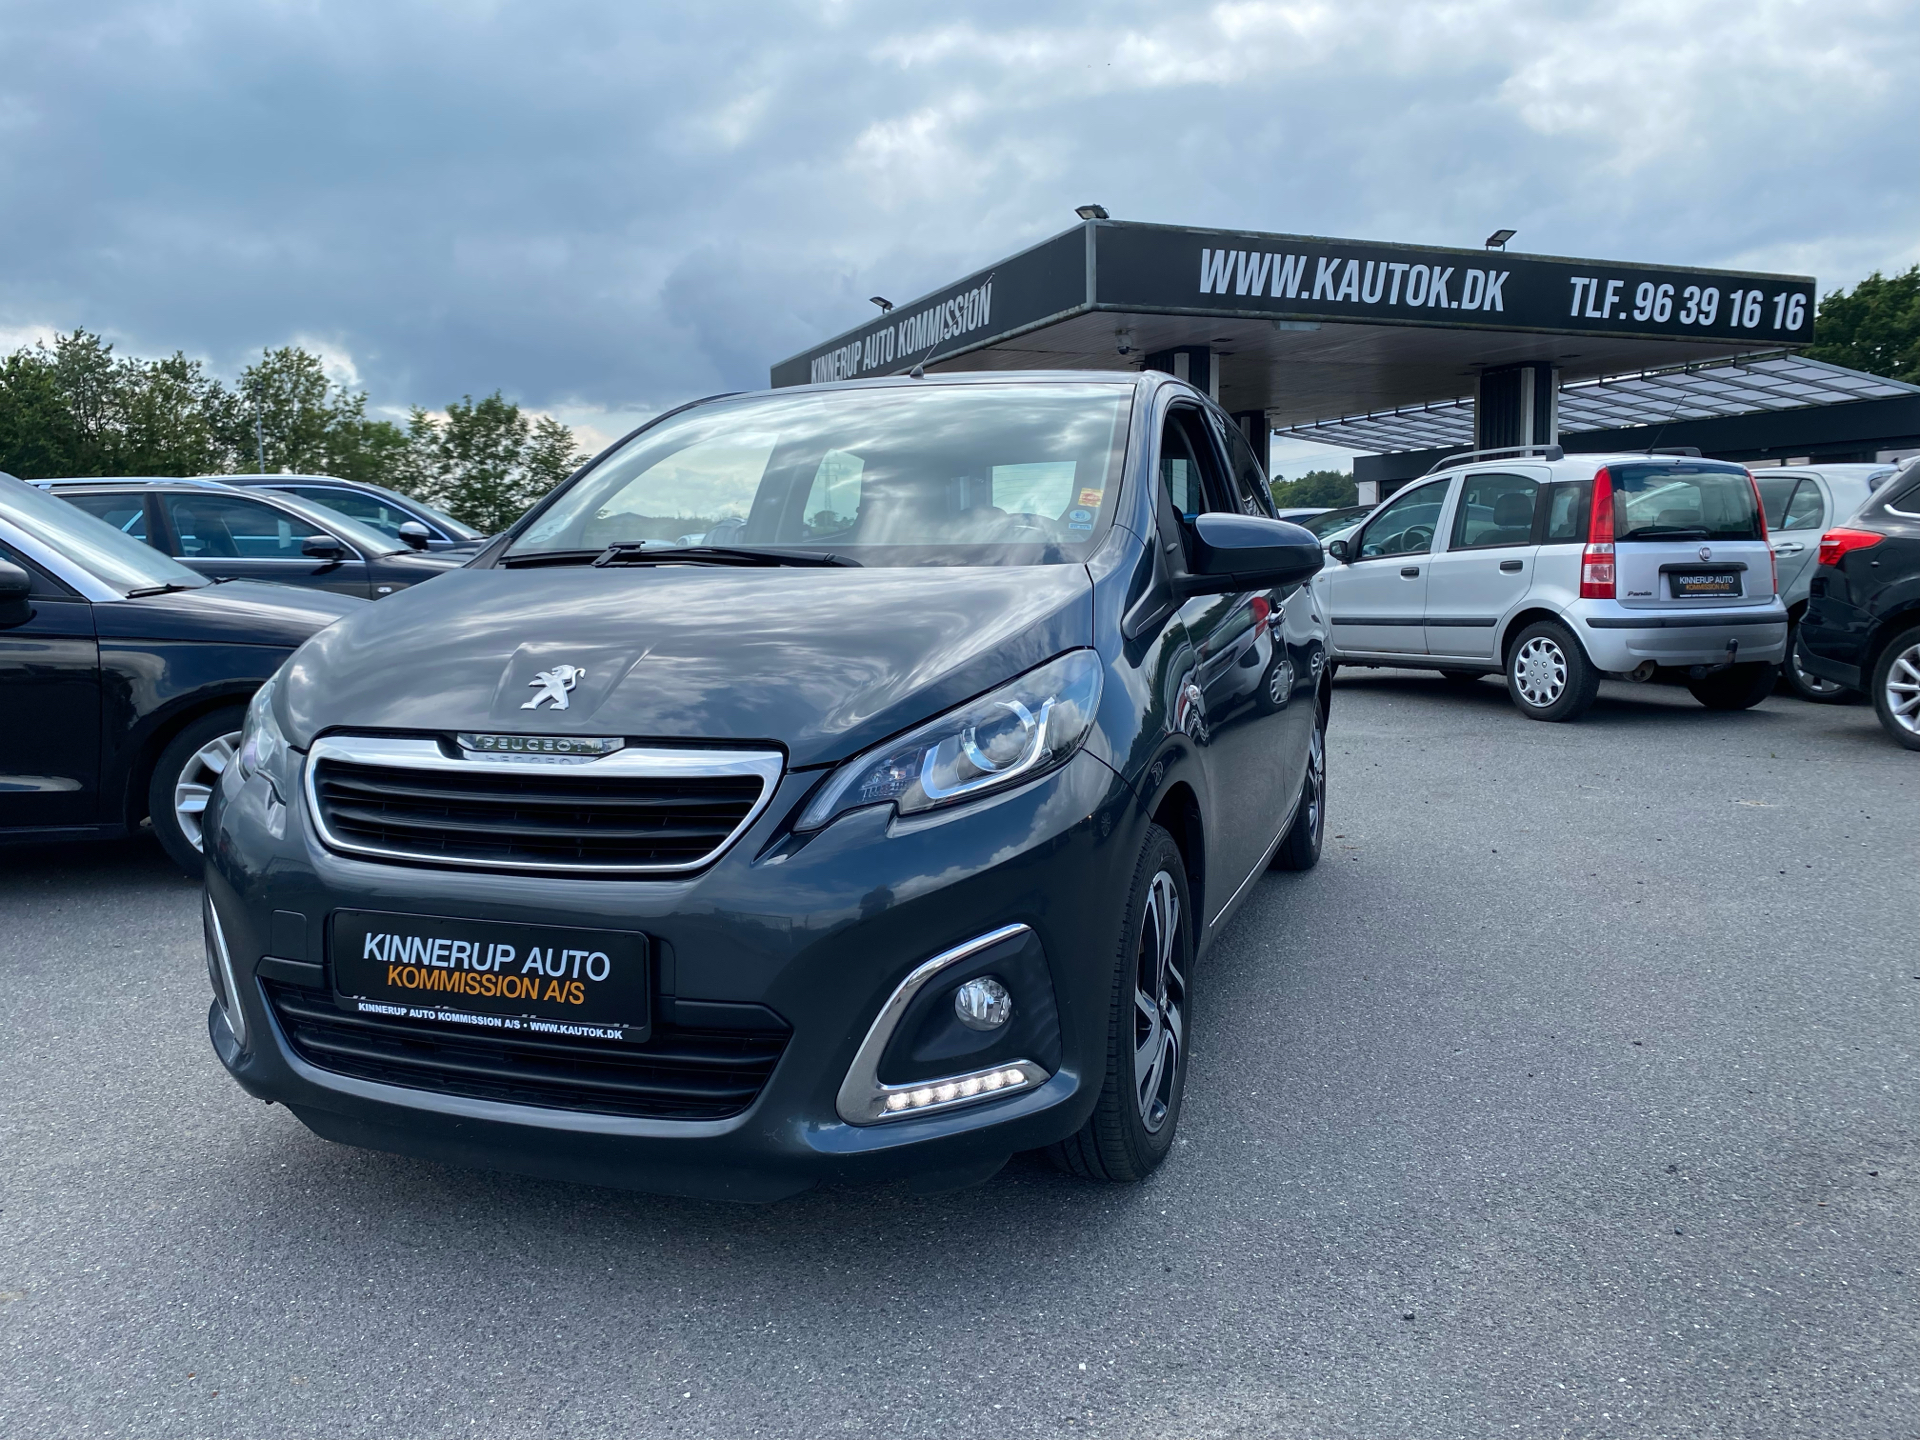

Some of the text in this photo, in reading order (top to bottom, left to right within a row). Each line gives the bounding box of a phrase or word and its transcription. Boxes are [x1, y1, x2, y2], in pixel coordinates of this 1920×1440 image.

[1200, 248, 1510, 312] WWW.KAUTOK.DK
[1570, 277, 1807, 331] TLF. 96 39 16 16
[811, 283, 992, 384] KINNERUP AUTO KOMMISSION
[1679, 576, 1734, 585] KINNERUP AUTO
[483, 737, 586, 752] PEUGEOT
[363, 932, 611, 982] KINNERUP AUTO
[387, 965, 586, 1005] KOMMISSION A/S
[358, 1002, 623, 1040] KINNERUP AUTO KOMMISSION A/S WWW.KAUTOK.DK
